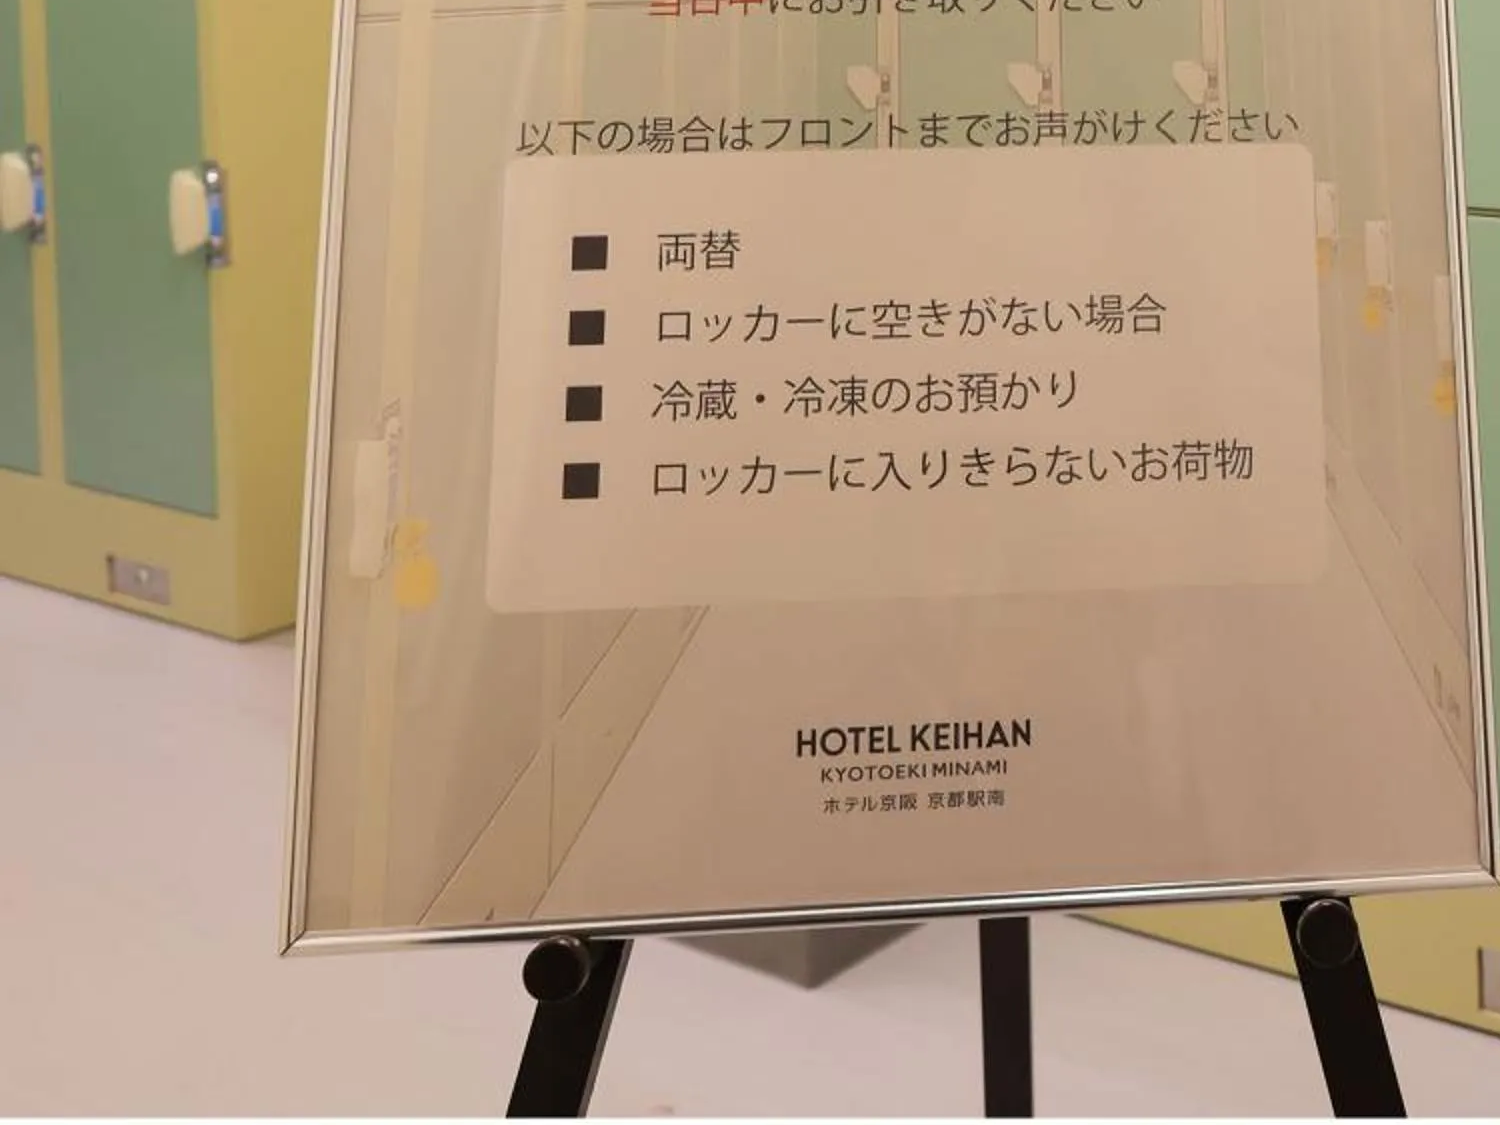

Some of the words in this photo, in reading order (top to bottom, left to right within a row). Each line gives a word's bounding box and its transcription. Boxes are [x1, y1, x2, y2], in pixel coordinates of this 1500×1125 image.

[516, 108, 1300, 156] 以下の場合はフロントまでお声がけください
[656, 229, 741, 273] 両替
[657, 292, 1167, 343] ロッカーに空きがない場合
[651, 369, 1079, 423] 冷蔵・冷凍のお預かり
[652, 438, 1254, 496] ロッカーに入りきらないお荷物
[796, 726, 903, 758] HOTEL
[910, 718, 1032, 752] KEIHAN
[821, 763, 928, 784] KYOTOEKI
[932, 759, 1008, 777] MINAMI
[823, 794, 918, 814] ホテル京阪
[928, 789, 1005, 810] 京都駅南
